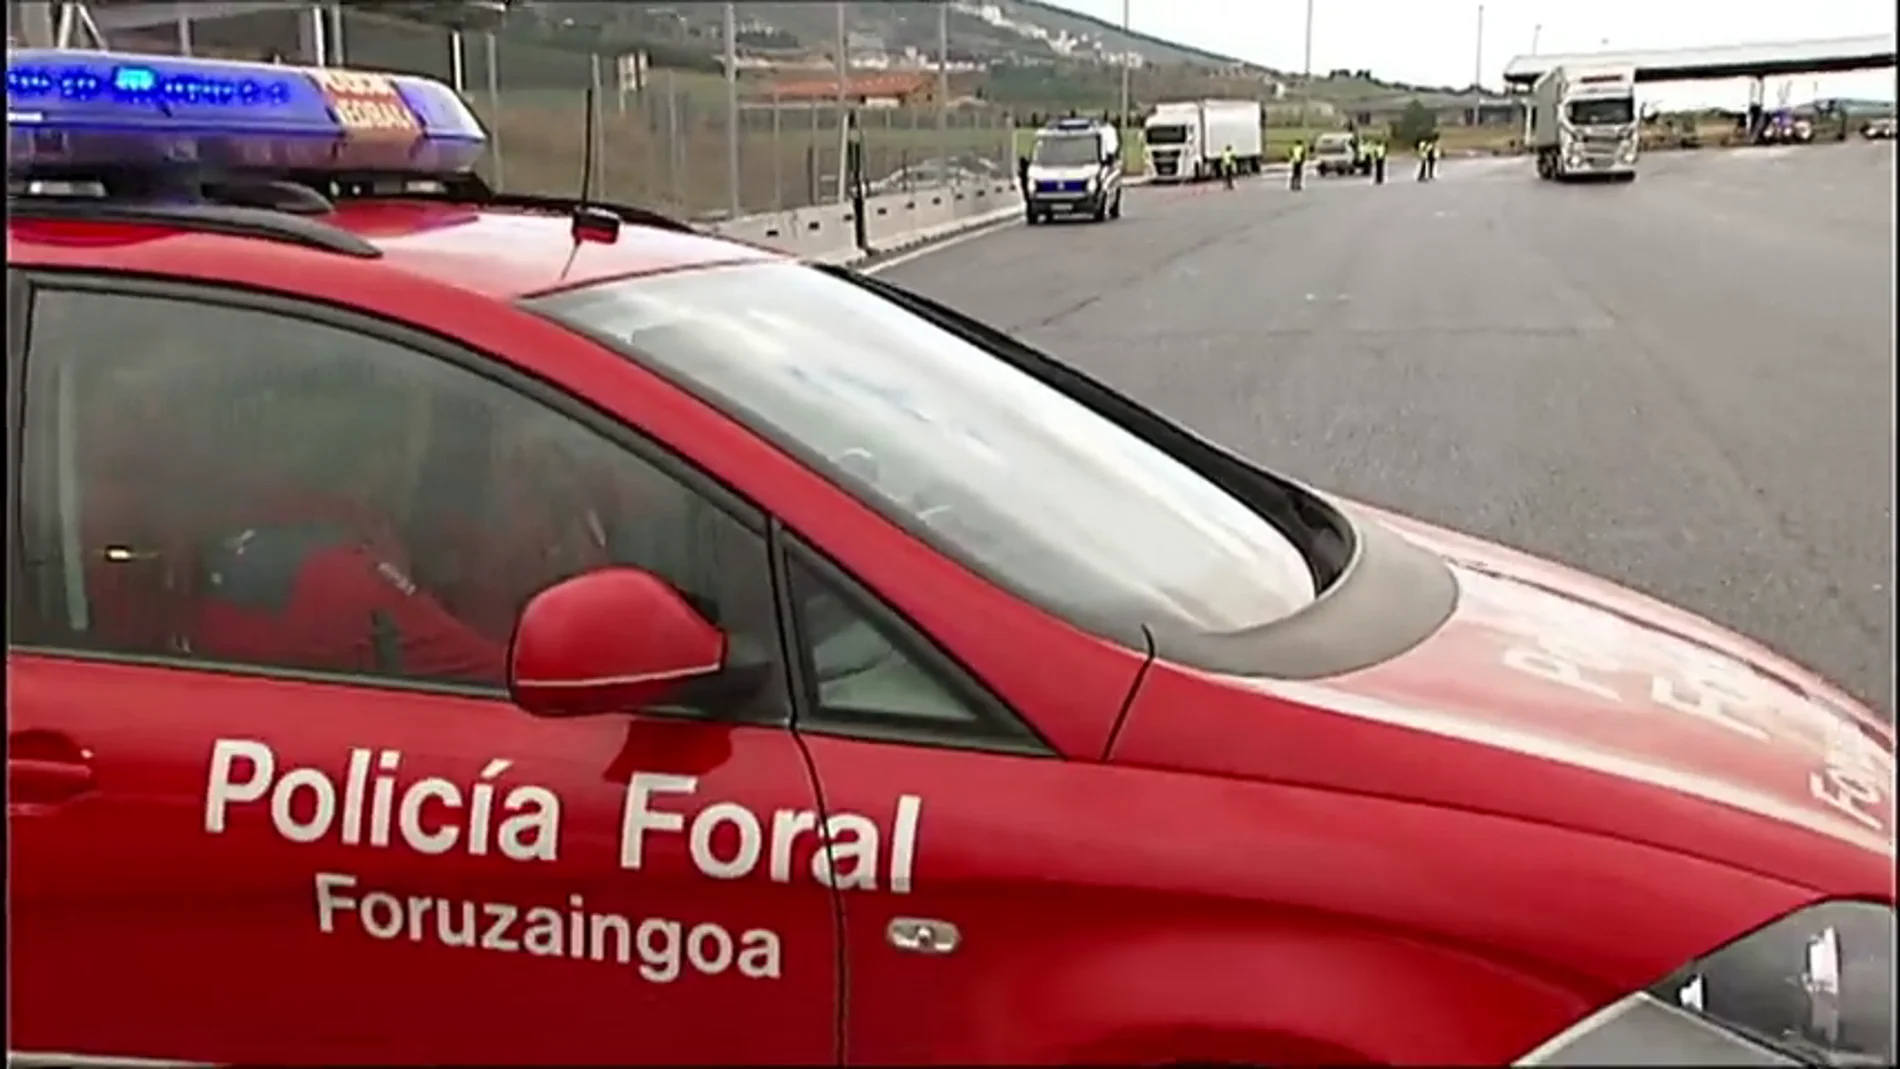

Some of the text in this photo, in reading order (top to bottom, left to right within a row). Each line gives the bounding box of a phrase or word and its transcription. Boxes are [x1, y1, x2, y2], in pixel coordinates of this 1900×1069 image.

[206, 739, 922, 893] Policía Foral
[316, 874, 781, 981] Foruzaingoa
